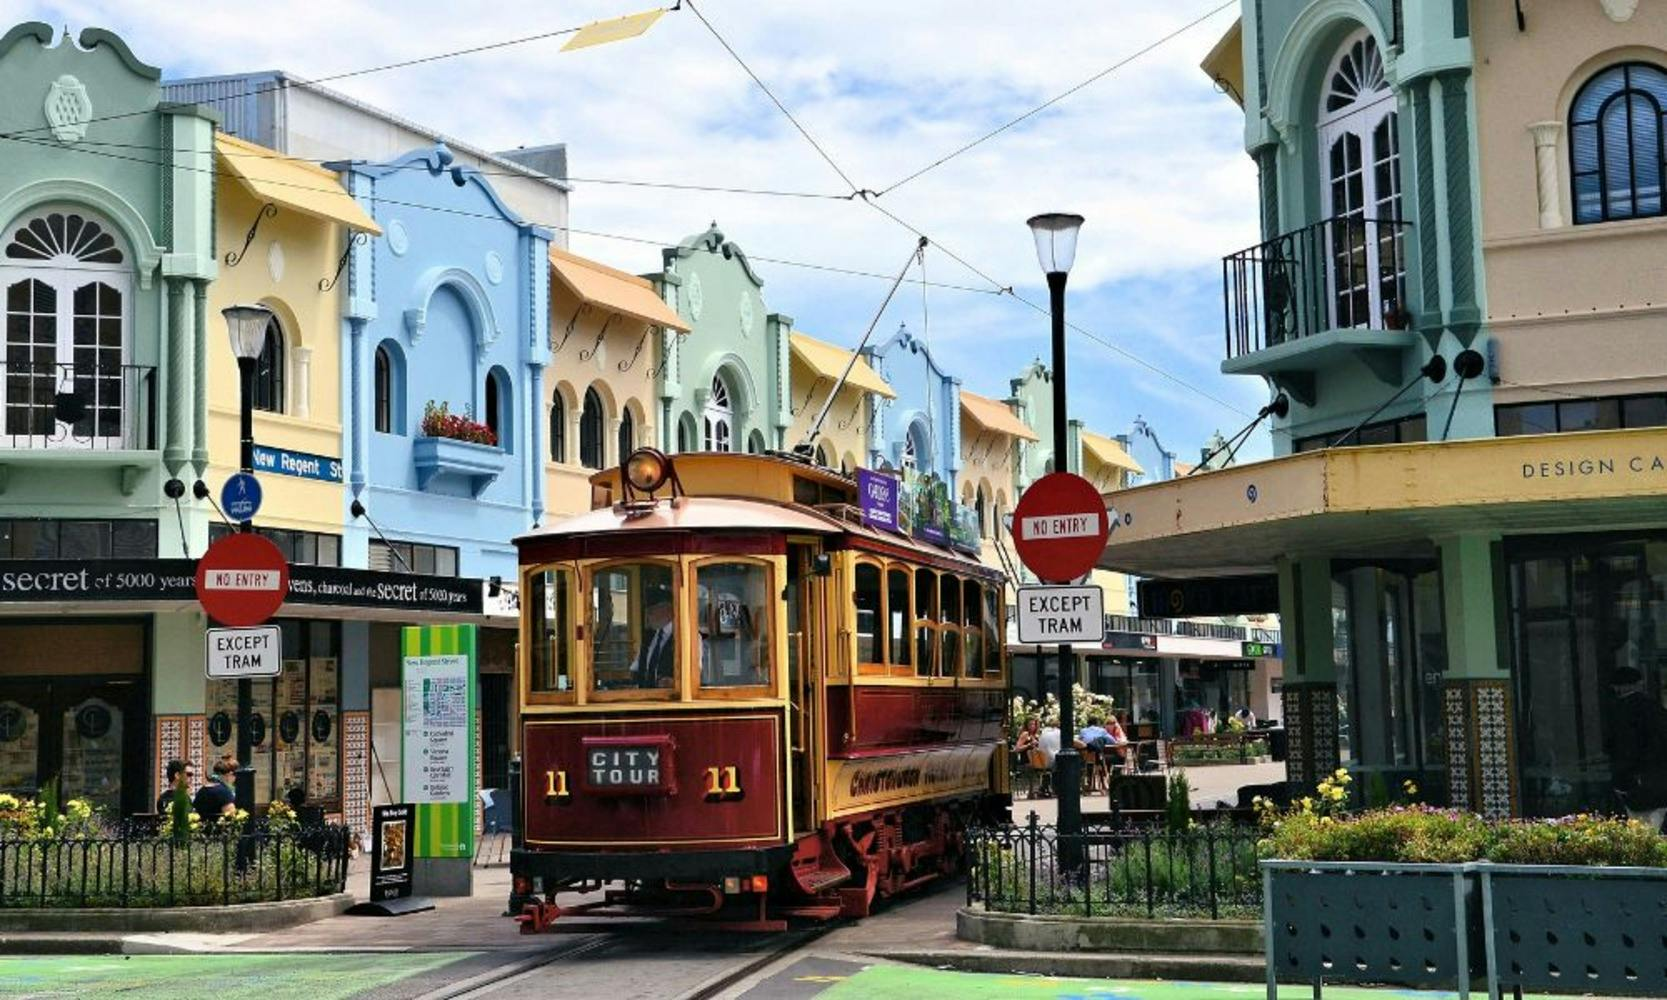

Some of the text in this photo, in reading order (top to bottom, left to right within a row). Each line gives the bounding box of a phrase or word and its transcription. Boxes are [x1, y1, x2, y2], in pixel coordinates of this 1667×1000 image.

[253, 448, 343, 478] New Regent St
[1522, 456, 1665, 478] DESIGN CA
[1033, 518, 1088, 536] NO ENTRY
[3, 567, 90, 591] secret
[94, 572, 114, 589] of
[116, 572, 155, 588] 5000
[215, 573, 269, 587] NO ENTRY
[287, 579, 317, 596] vens,
[318, 580, 353, 596] charcoal
[377, 581, 418, 602] secret
[419, 588, 428, 600] of
[429, 588, 447, 602] 5000
[448, 591, 468, 606] years
[1029, 596, 1091, 613] EXCEPT
[1038, 617, 1083, 634] TRAM
[217, 635, 269, 651] EXCEPT
[224, 654, 262, 669] TRAM
[592, 751, 660, 766] CITY
[545, 771, 570, 796] 11
[592, 769, 660, 784] TOUR
[706, 766, 742, 794] 11
